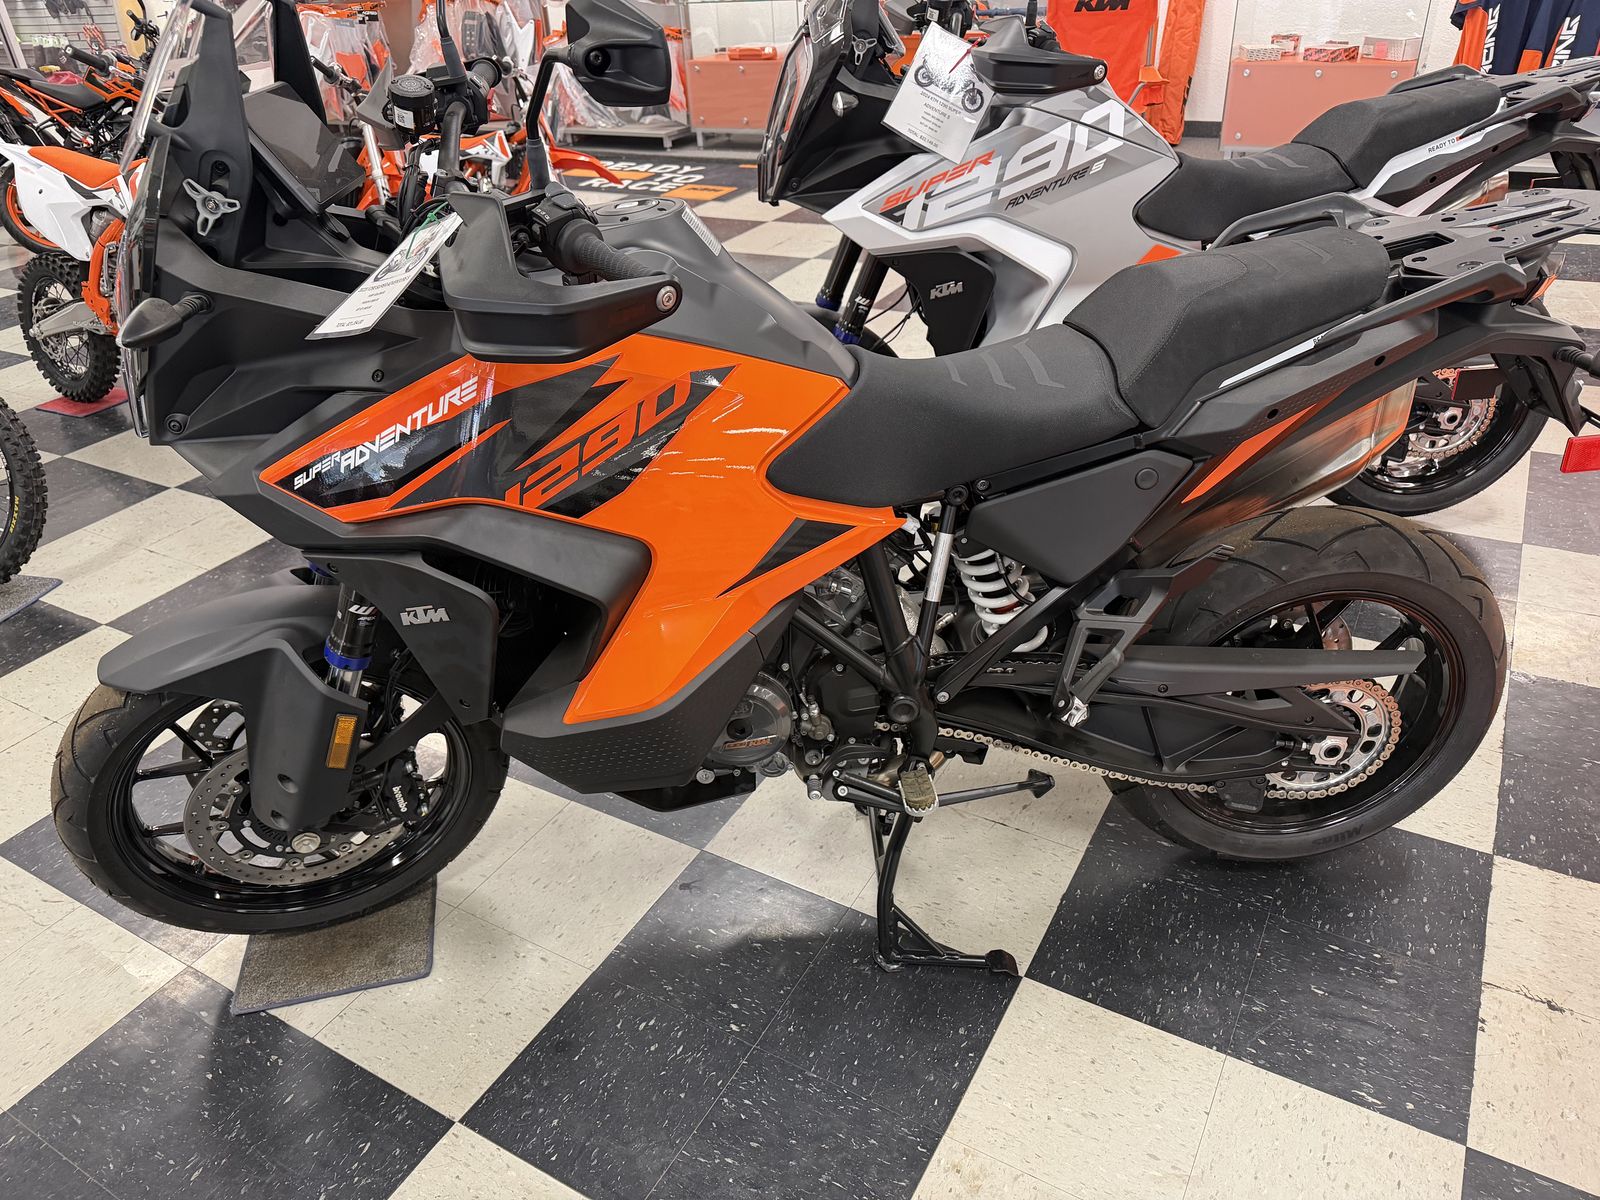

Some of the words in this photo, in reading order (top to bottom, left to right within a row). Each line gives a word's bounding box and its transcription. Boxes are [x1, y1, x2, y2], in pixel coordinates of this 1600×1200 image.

[1480, 3, 1501, 74] ACING
[1427, 142, 1447, 154] READY
[1447, 138, 1456, 146] TO
[654, 173, 705, 183] TO
[880, 148, 996, 213] SUPER
[1005, 166, 1090, 211] ADVENTURE
[1089, 158, 1107, 175] S
[930, 281, 963, 300] KTM
[293, 451, 340, 490] SUPER
[340, 376, 479, 474] ADVENTURE
[504, 376, 691, 509] 1290
[400, 604, 450, 626] KTM
[392, 786, 408, 813] brembo
